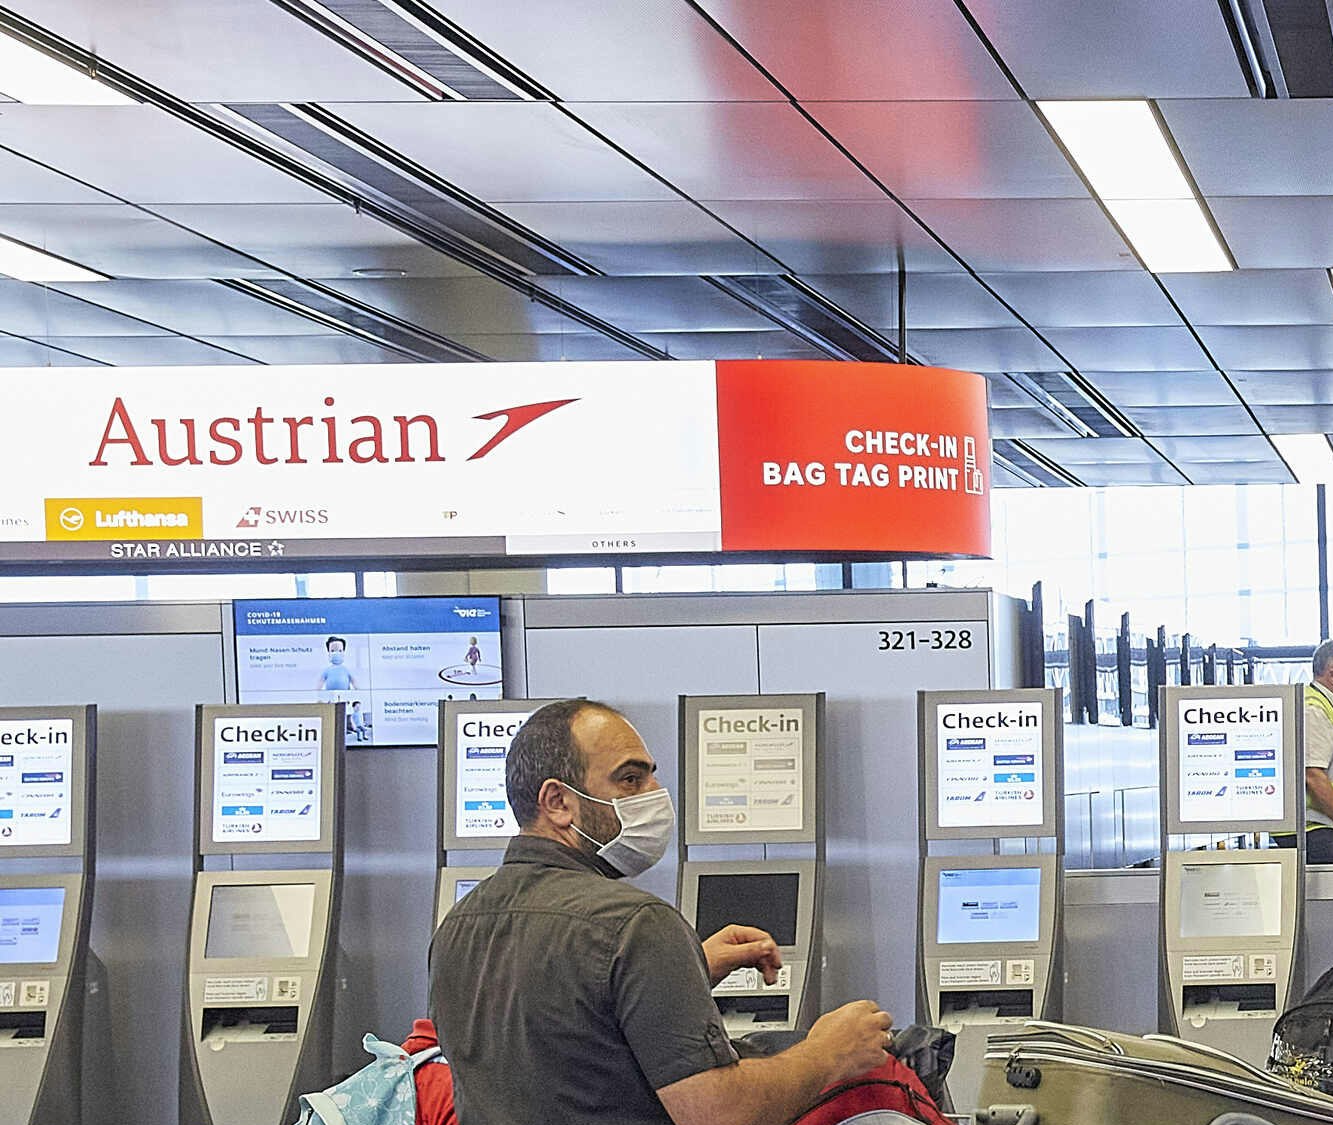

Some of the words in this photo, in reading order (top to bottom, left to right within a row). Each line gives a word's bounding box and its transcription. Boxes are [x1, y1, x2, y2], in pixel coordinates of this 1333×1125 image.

[88, 397, 446, 467] Austrian
[845, 430, 958, 459] CHECK-IN
[763, 461, 826, 486] BAG
[834, 462, 891, 487] TAG
[898, 463, 959, 492] PRINT
[95, 510, 189, 529] Lufthansa
[265, 507, 329, 526] SWISS
[111, 543, 161, 559] STAR
[166, 541, 262, 558] ALLIANCE
[591, 539, 637, 549] OTHERS
[247, 617, 327, 625] SCHUTZMASSNAHMEN
[703, 713, 799, 734] Check-in
[942, 710, 1038, 729] Check-in
[1183, 705, 1279, 724] Check-in
[0, 726, 68, 745] eck-in
[220, 723, 318, 743] Check-in
[463, 720, 523, 737] Chec
